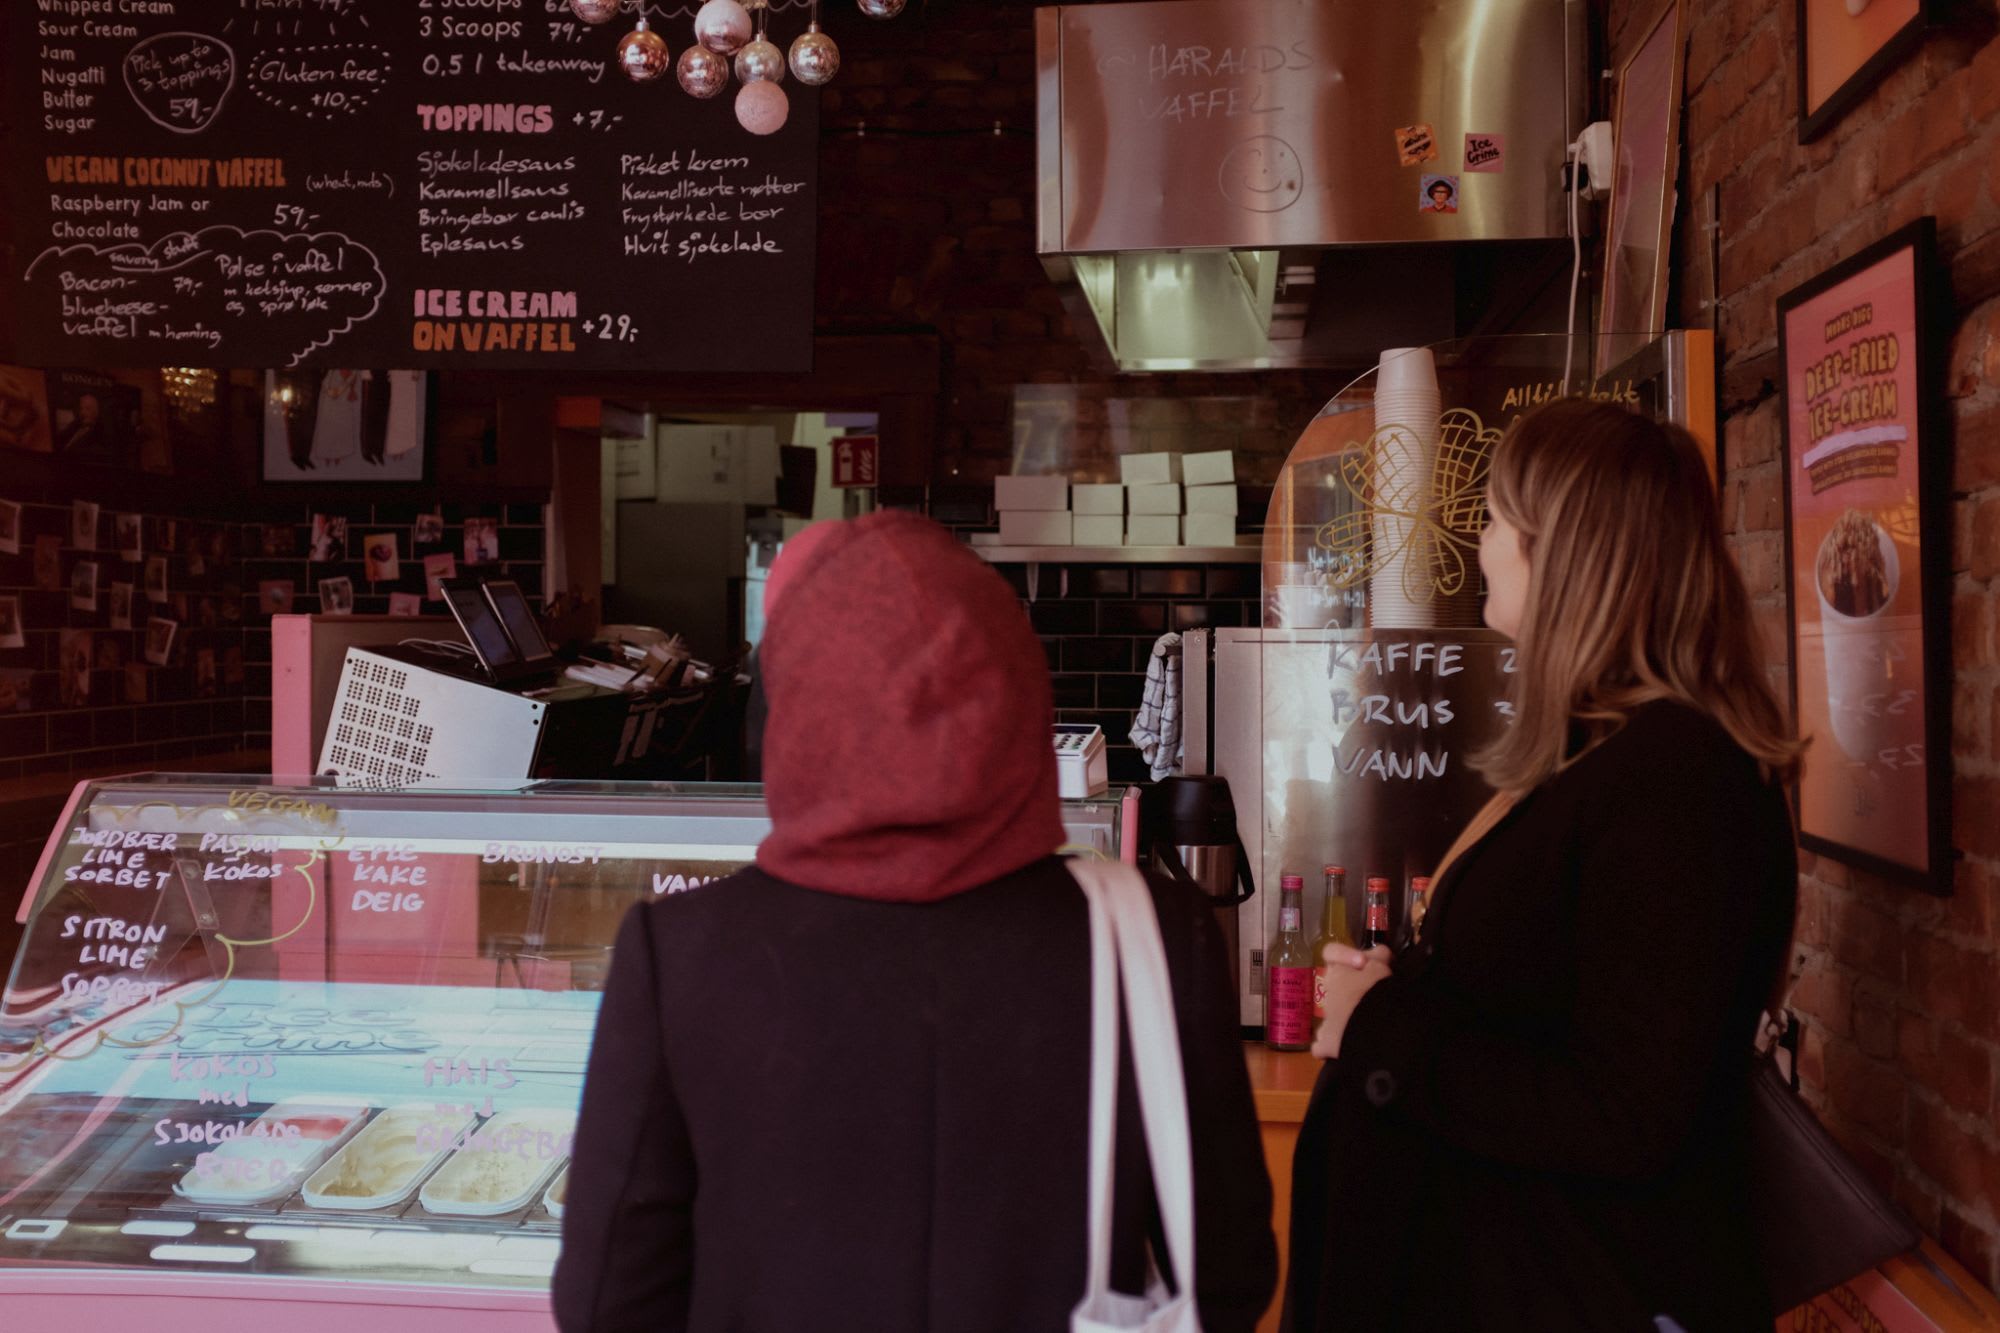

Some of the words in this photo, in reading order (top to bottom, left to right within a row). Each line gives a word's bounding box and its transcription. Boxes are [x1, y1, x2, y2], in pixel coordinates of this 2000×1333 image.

[118, 0, 175, 14] Cream
[38, 21, 79, 36] Sour
[83, 20, 137, 37] Cream
[419, 15, 433, 37] 3
[442, 16, 522, 42] Scoops
[548, 22, 592, 43] 79,-
[40, 45, 76, 61] Jam
[130, 50, 162, 74] Pick
[168, 53, 190, 70] up
[190, 40, 210, 57] to
[496, 49, 605, 84] takeaway
[1149, 40, 1315, 82] HARALDS
[41, 67, 106, 87] Nugatti
[138, 77, 153, 92] 3
[158, 59, 230, 90] toppings
[259, 61, 335, 83] Gluten
[340, 59, 378, 82] free
[43, 90, 94, 109] Butter
[169, 97, 213, 124] 59,-
[311, 91, 361, 110] +10,-
[44, 114, 97, 135] Sugar
[416, 103, 554, 134] TOPPINGS
[572, 109, 624, 132] +7,-
[1468, 139, 1493, 153] Ice
[46, 155, 120, 184] VEGAN
[123, 157, 211, 188] COCONUT
[215, 157, 287, 188] VAFFEL
[417, 149, 576, 179] Sjokoladesaus
[620, 150, 680, 176] Pisket
[687, 148, 750, 171] krem
[418, 175, 570, 201] Karamellsaus
[622, 174, 736, 201] Karamelliserte
[51, 193, 140, 217] Raspberry
[148, 193, 184, 211] Jam
[190, 200, 211, 211] or
[273, 203, 321, 231] 59,-
[52, 220, 140, 238] Chocolate
[420, 231, 526, 259] Eplesaus
[624, 229, 671, 256] Hvit
[677, 229, 785, 264] sjokolade
[285, 247, 344, 274] vaffel
[58, 270, 138, 292] Bacon-
[413, 289, 463, 318] ICE
[468, 290, 578, 319] CREAM
[62, 315, 136, 339] vaffel
[412, 320, 457, 351] ON
[459, 322, 577, 351] VAFFEL
[1806, 334, 1898, 402] DEEP-FRIED
[1809, 380, 1898, 442] ICE-CREAM
[1327, 640, 1464, 680] KAFFE
[1331, 690, 1454, 729] BRUS
[1331, 745, 1449, 782] VANN
[227, 790, 338, 824] VEGAN
[69, 826, 178, 851] JORDBÆR
[82, 849, 145, 869] LIME
[482, 842, 604, 865] BRUNOST
[64, 865, 171, 890] SORBET
[203, 862, 283, 881] KOKOS
[353, 863, 427, 886] KAKE
[351, 890, 425, 912] DEIG
[60, 916, 167, 944] SITRON
[79, 945, 148, 969] LIME
[170, 1052, 277, 1082] KOKOS
[199, 1082, 249, 1107] med
